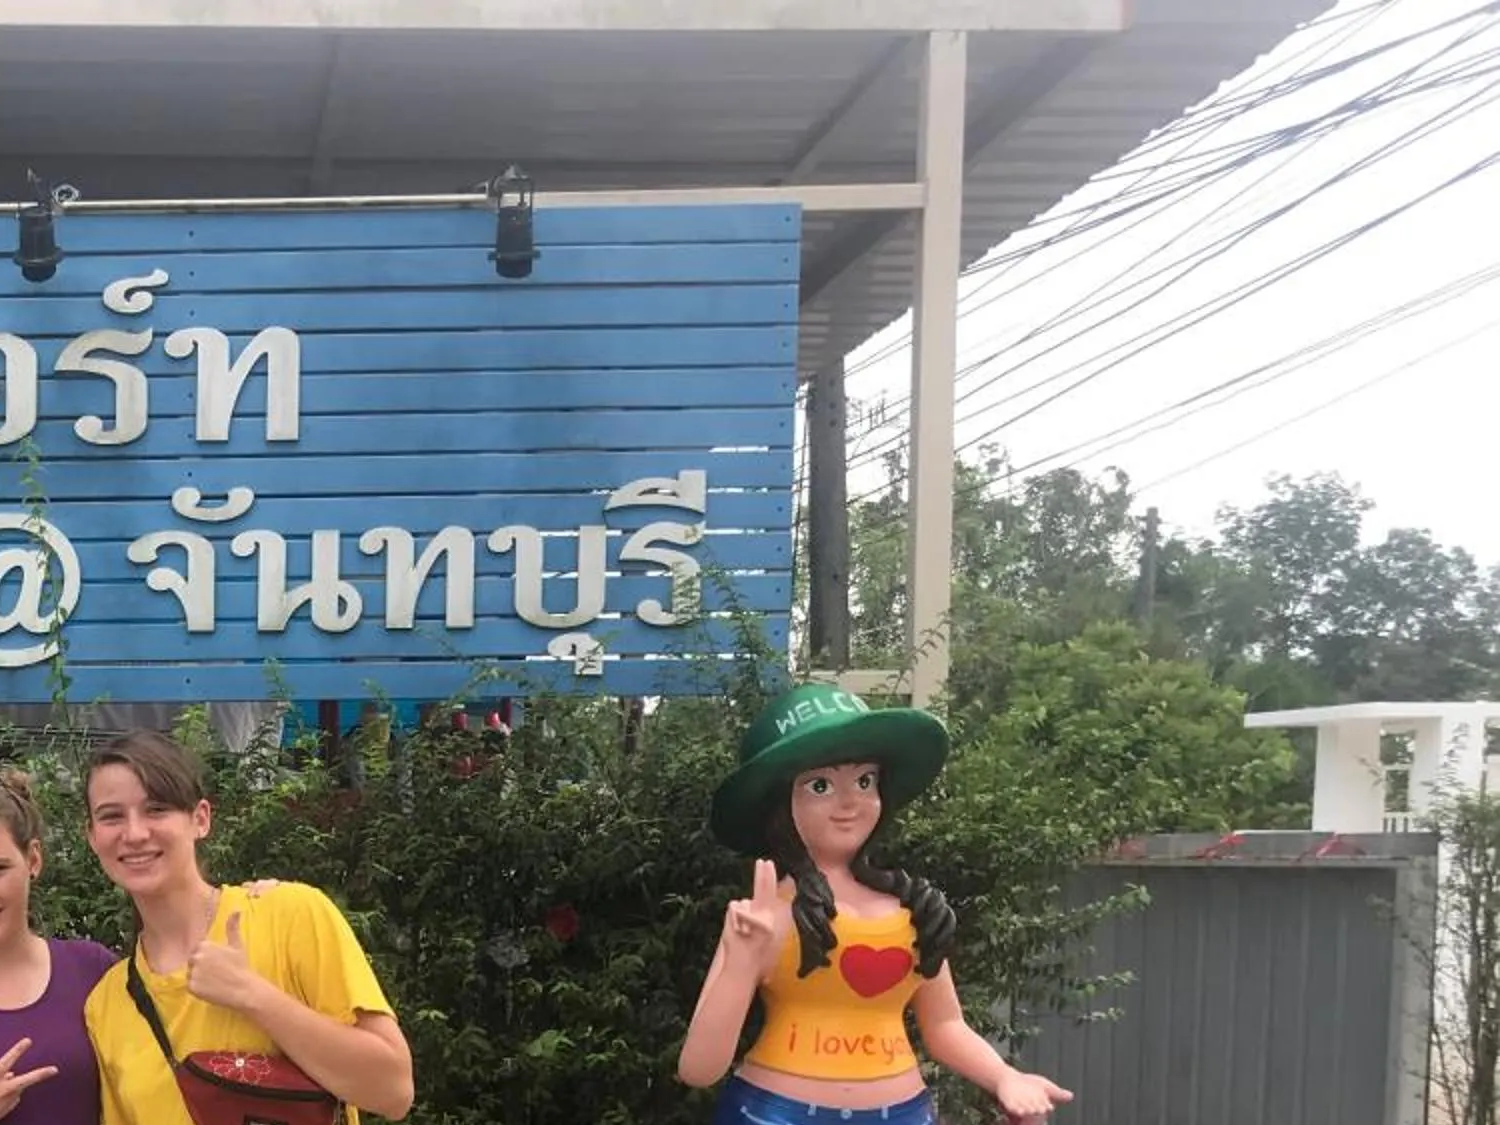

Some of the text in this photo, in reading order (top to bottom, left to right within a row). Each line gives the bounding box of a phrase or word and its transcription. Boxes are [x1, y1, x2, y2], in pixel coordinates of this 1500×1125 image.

[127, 469, 706, 675] จันทบุรี
[788, 1023, 797, 1053] i
[814, 1027, 875, 1056] love
